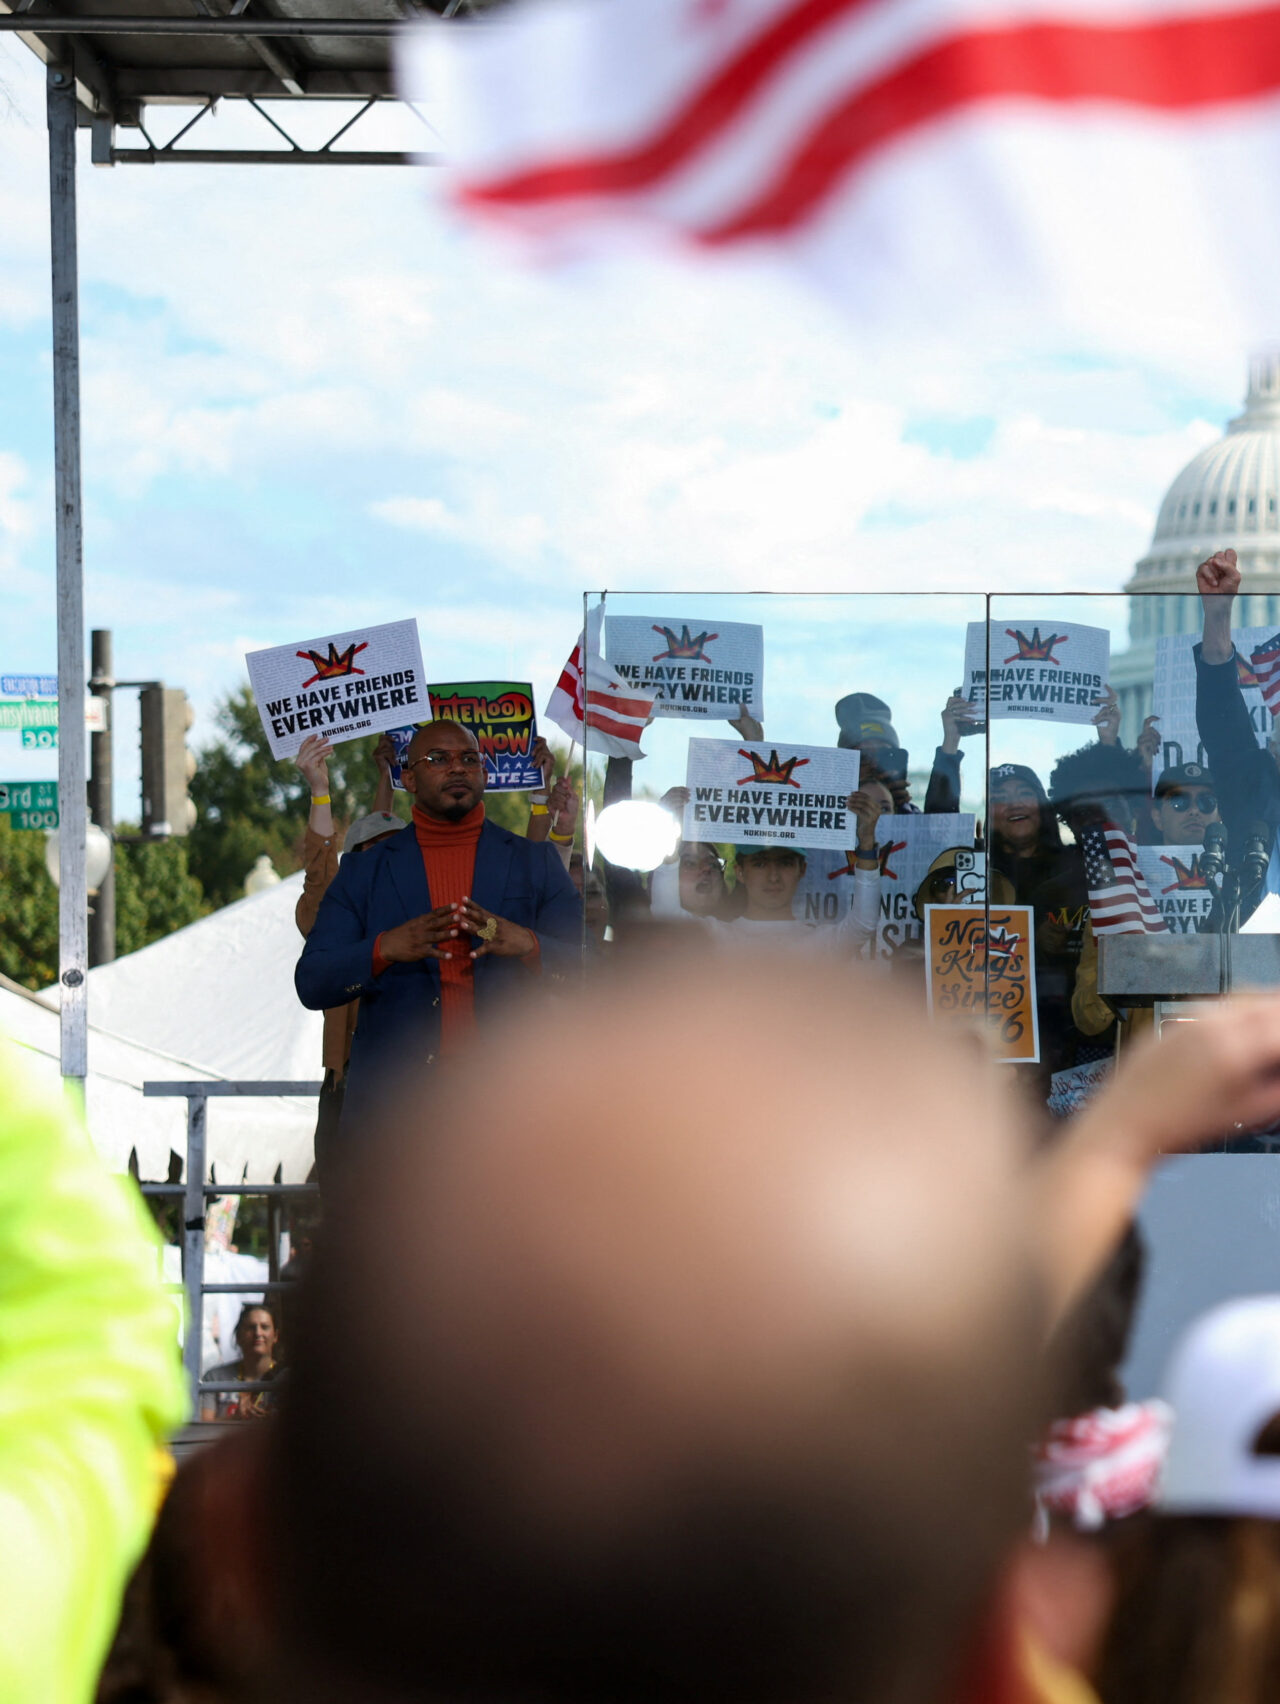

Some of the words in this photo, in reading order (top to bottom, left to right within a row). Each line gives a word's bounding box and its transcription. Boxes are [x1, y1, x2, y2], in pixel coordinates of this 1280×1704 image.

[614, 665, 640, 679] WE
[645, 667, 685, 680] HAVE
[691, 668, 753, 685] FRIENDS
[1040, 669, 1101, 687] FRIENDS
[266, 698, 292, 717] WE
[296, 686, 341, 709] HAVE
[345, 669, 414, 697] FRIENDS
[271, 685, 418, 738] EVERYWHERE
[1008, 706, 1054, 714] NOKINGS.ORG
[322, 720, 371, 738] NOKINGS.ORG
[695, 787, 723, 802] WE
[728, 789, 772, 805] HAVE
[778, 792, 847, 809] FRIENDS
[21, 811, 57, 828] 100
[694, 804, 846, 830] EVERYWHERE
[744, 830, 795, 838] NOKINGS.ORG
[805, 892, 839, 920] NO
[1156, 899, 1197, 912] HAVE
